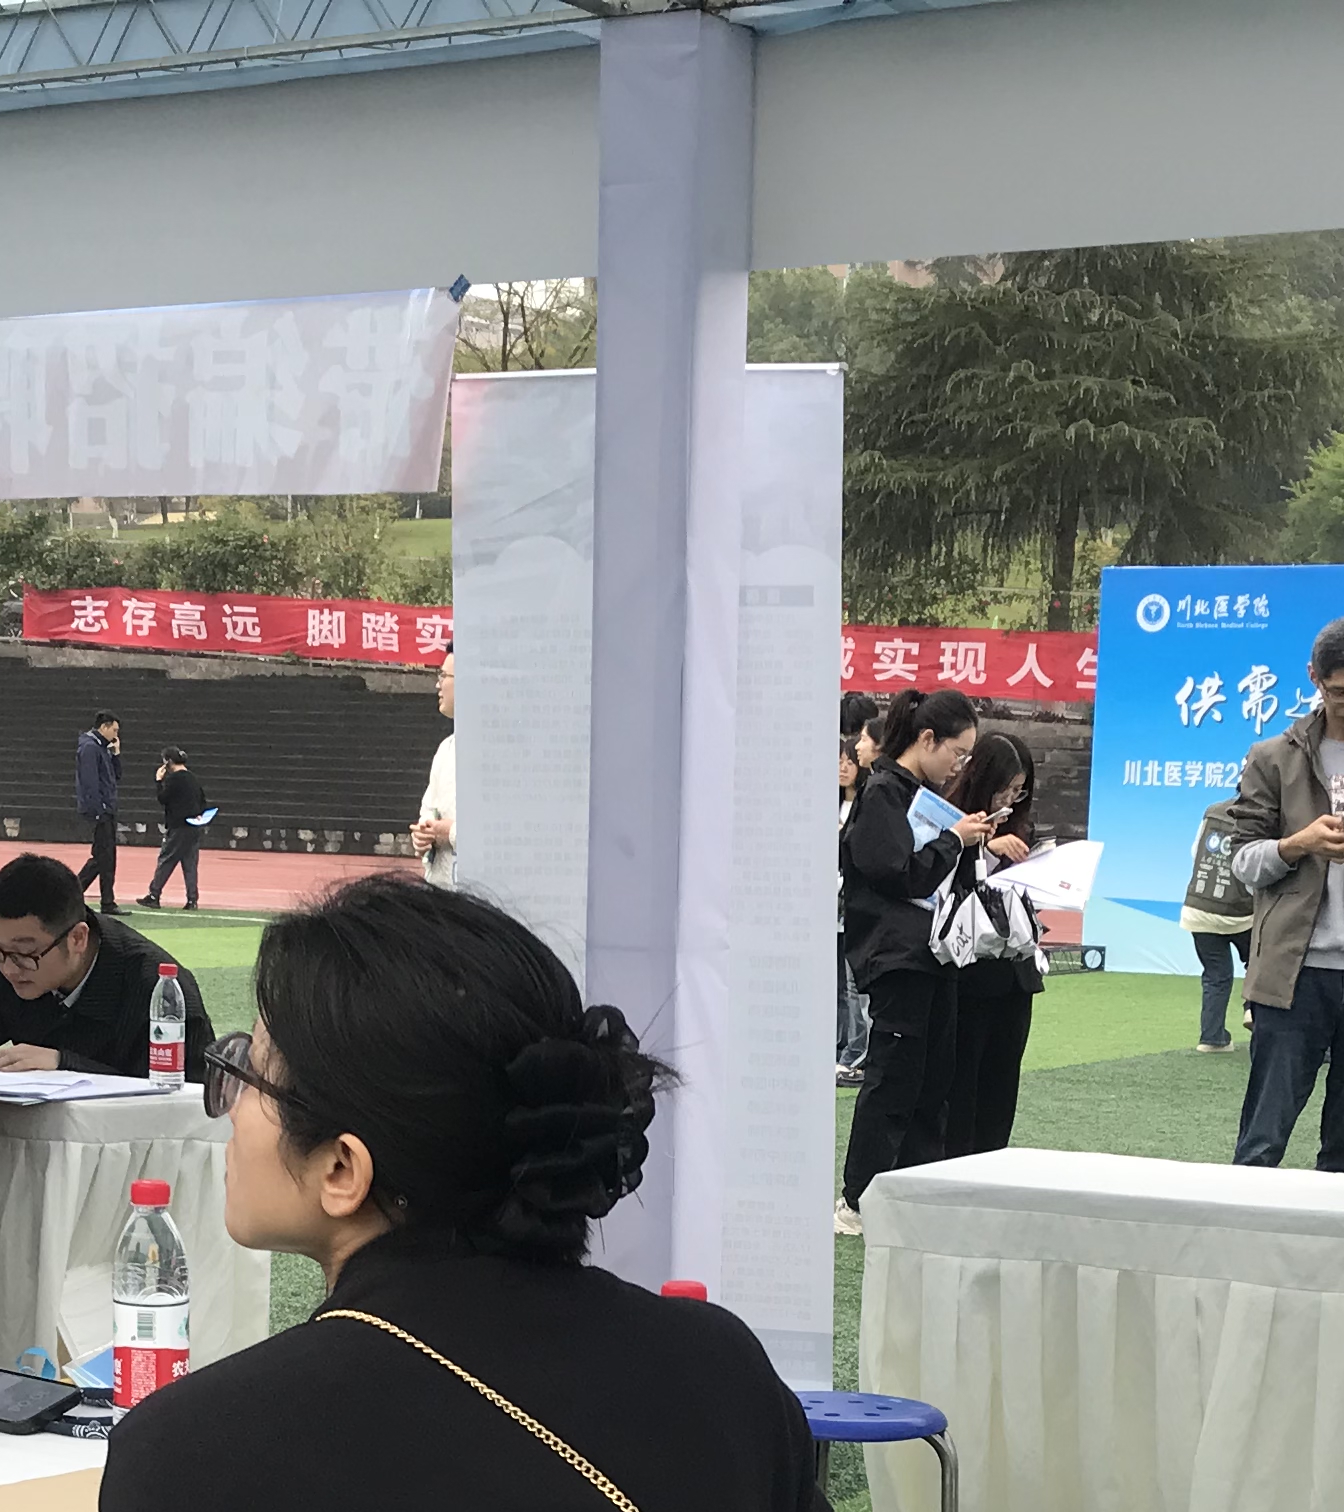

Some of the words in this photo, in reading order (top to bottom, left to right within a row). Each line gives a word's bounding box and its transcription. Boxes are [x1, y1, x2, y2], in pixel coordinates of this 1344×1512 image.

[1176, 593, 1270, 621] 川北医学院
[70, 594, 263, 645] 志存高远
[306, 606, 453, 656] 脚踏实
[1123, 759, 1243, 788] 川北医学院2
